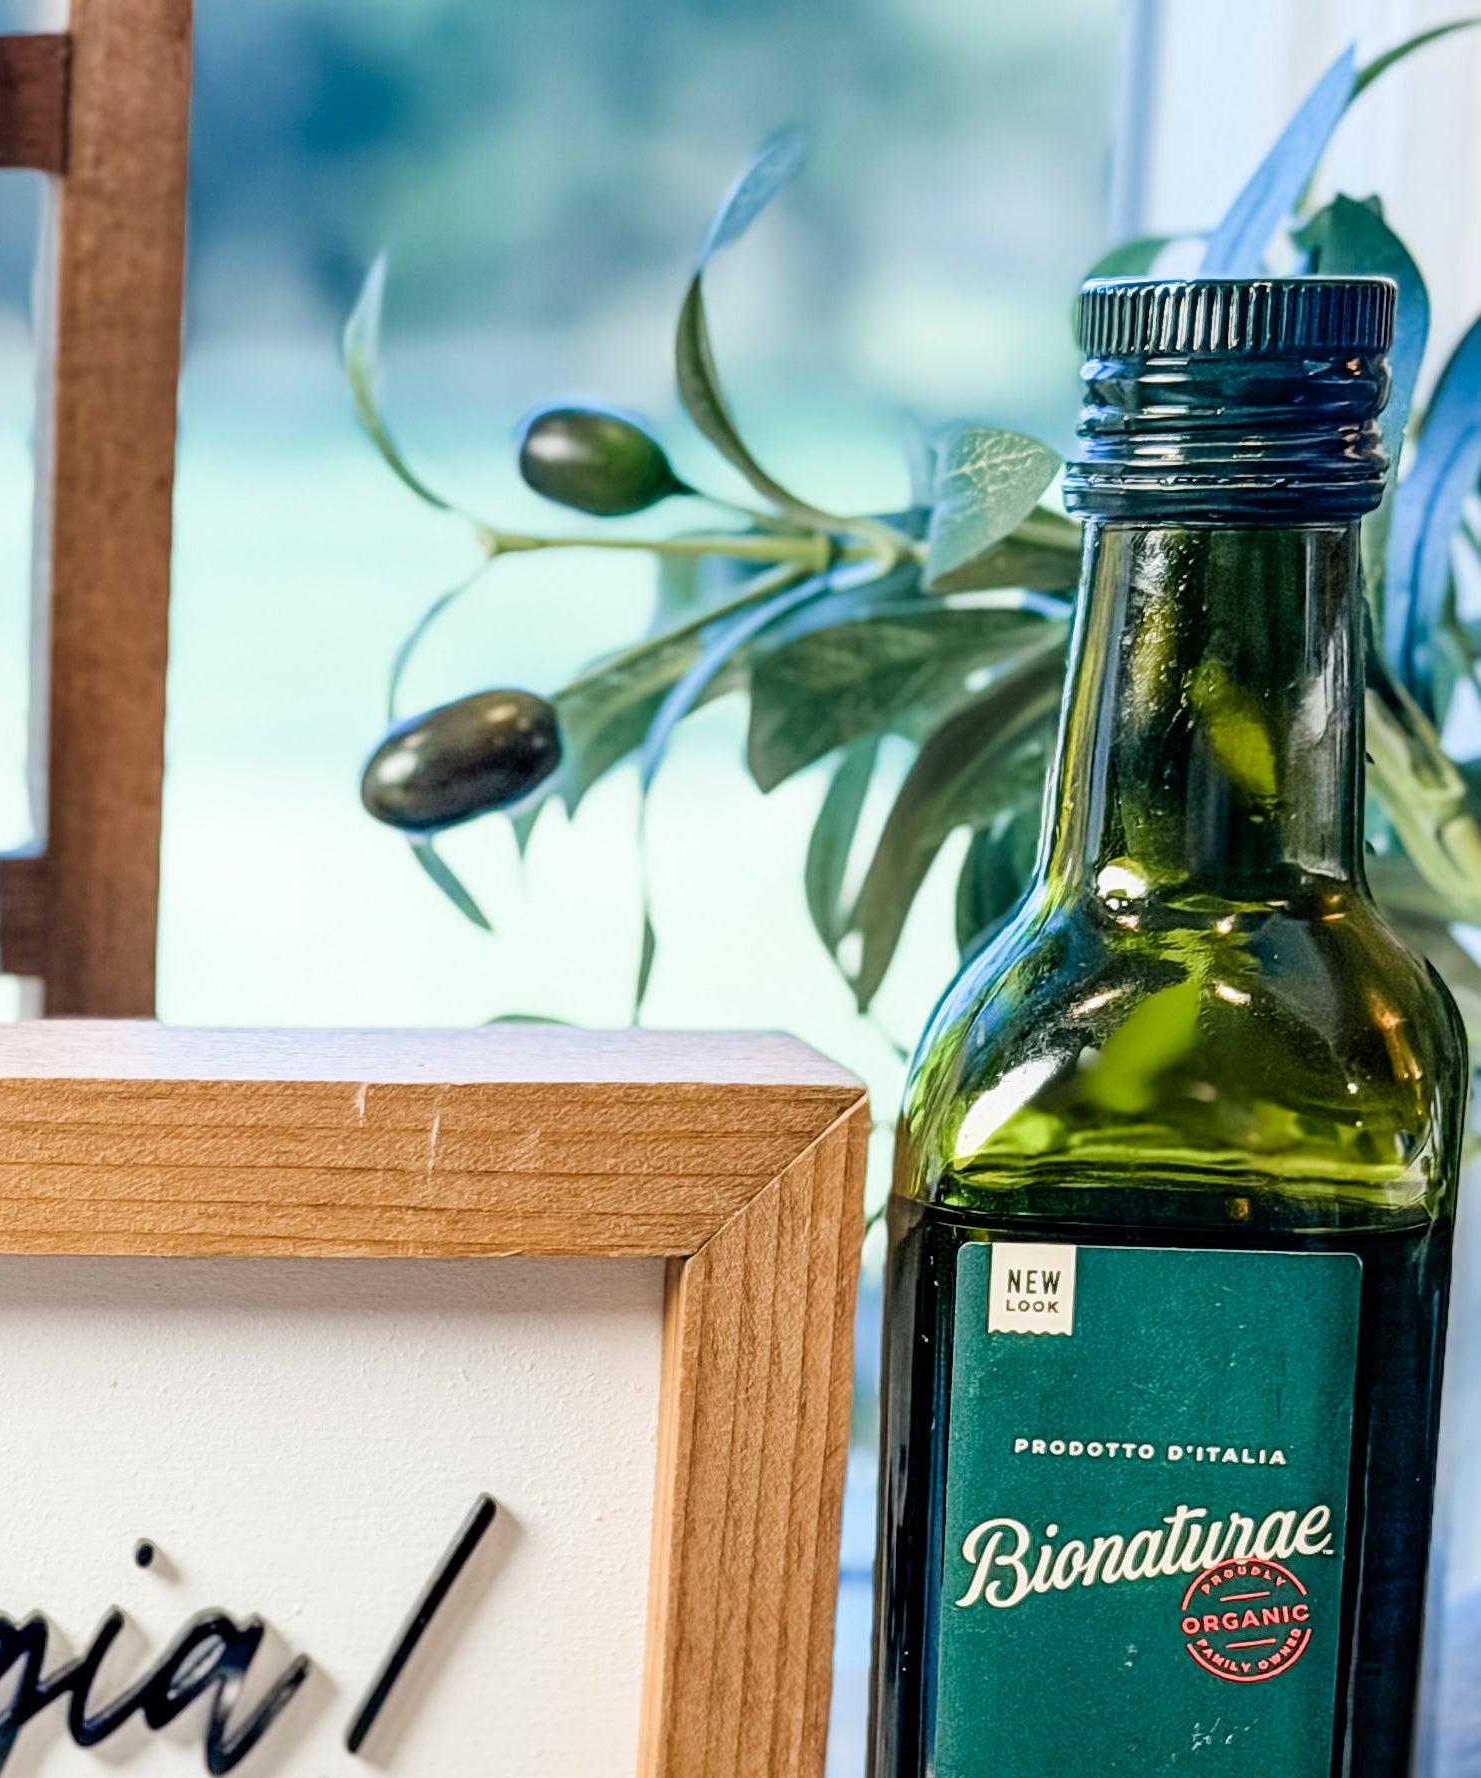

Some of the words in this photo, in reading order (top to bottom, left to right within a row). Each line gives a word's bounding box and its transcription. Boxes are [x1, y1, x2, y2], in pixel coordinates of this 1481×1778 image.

[1007, 1268, 1061, 1295] NEW
[1005, 1299, 1059, 1314] LOOK
[1014, 1438, 1155, 1460] PRODOTTO
[1167, 1444, 1287, 1466] D'ITALIA
[954, 1504, 1332, 1609] Bionaturae
[1201, 1565, 1286, 1595] PROUDLY
[1181, 1604, 1310, 1636] ORGANIC
[1197, 1638, 1251, 1673] FAMILY
[1258, 1628, 1302, 1671] OWNED
